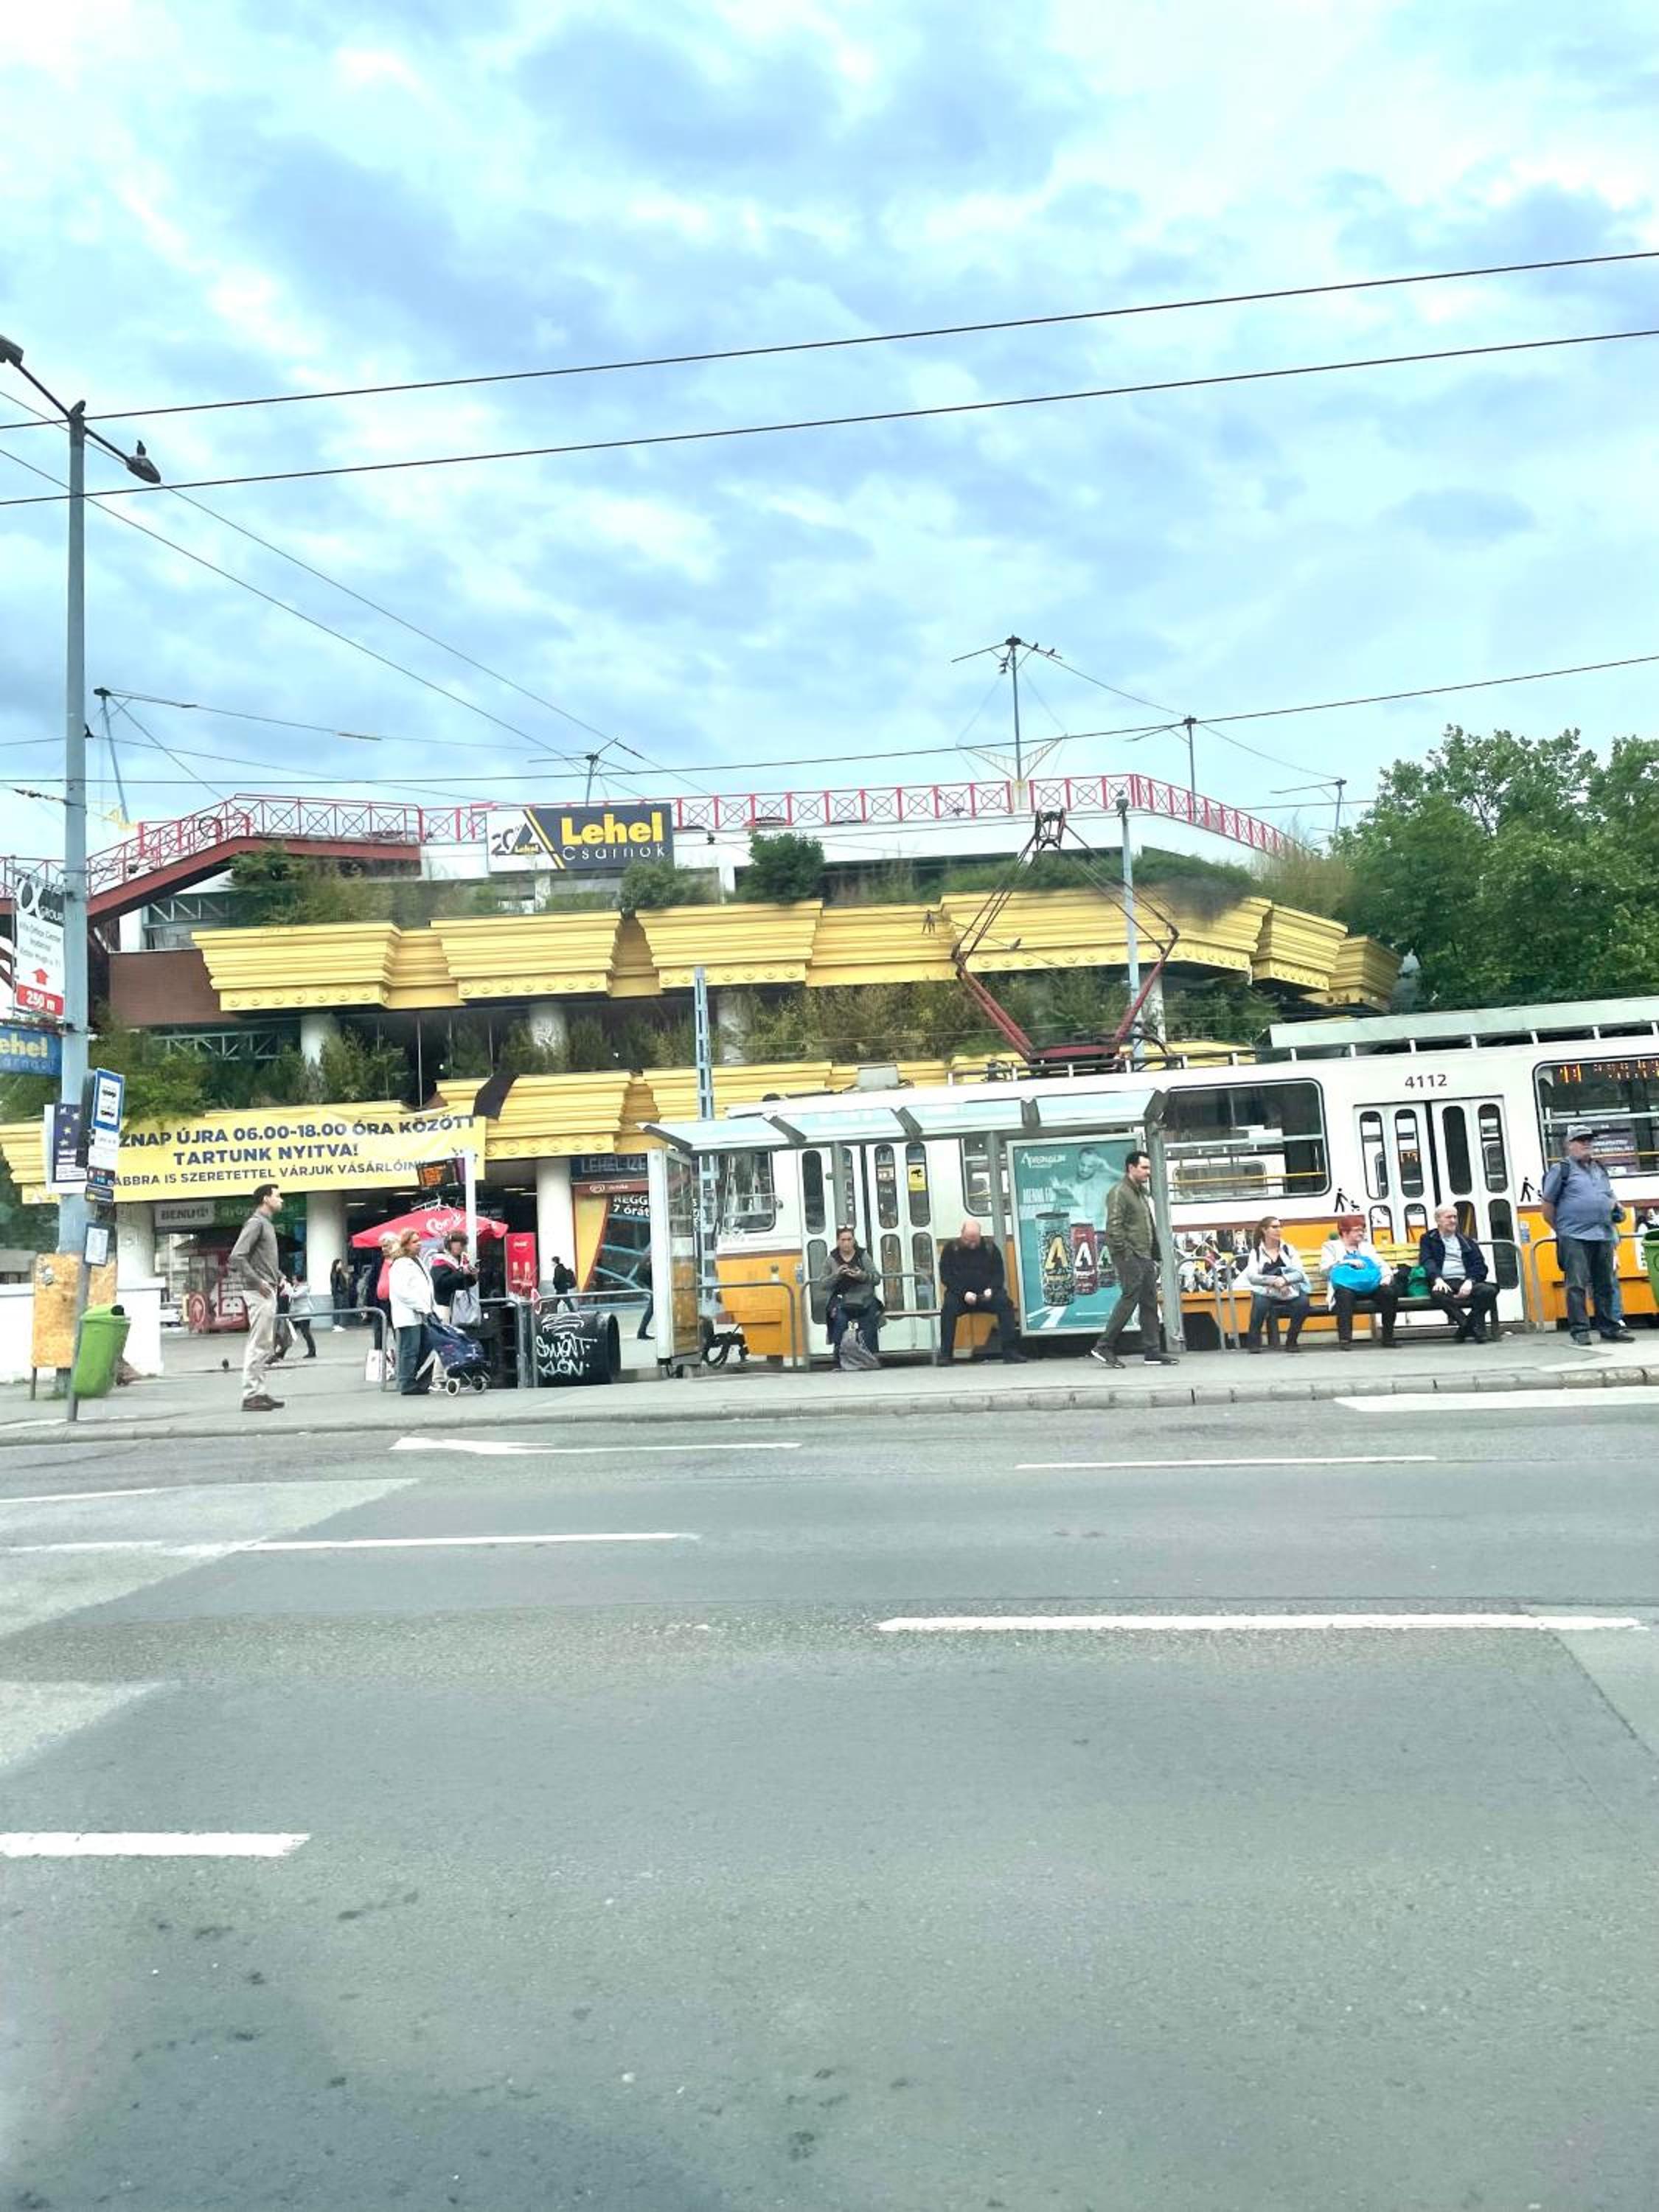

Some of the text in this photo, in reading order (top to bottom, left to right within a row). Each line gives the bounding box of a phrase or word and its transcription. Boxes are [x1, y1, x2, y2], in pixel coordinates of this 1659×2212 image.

[561, 812, 663, 845] Lehel
[563, 844, 665, 860] Csarnok
[1405, 1074, 1447, 1089] 4112
[176, 1127, 229, 1144] ÚJRA
[233, 1122, 347, 1141] 06.00-18.00
[352, 1119, 394, 1135] ÓRA
[399, 1114, 474, 1133] KÖZÖTT
[173, 1144, 359, 1166] TARTUNK NYITVA!
[164, 1174, 177, 1183] IS
[181, 1168, 275, 1183] SZERETETTEL
[279, 1162, 333, 1178] VÁRJUK
